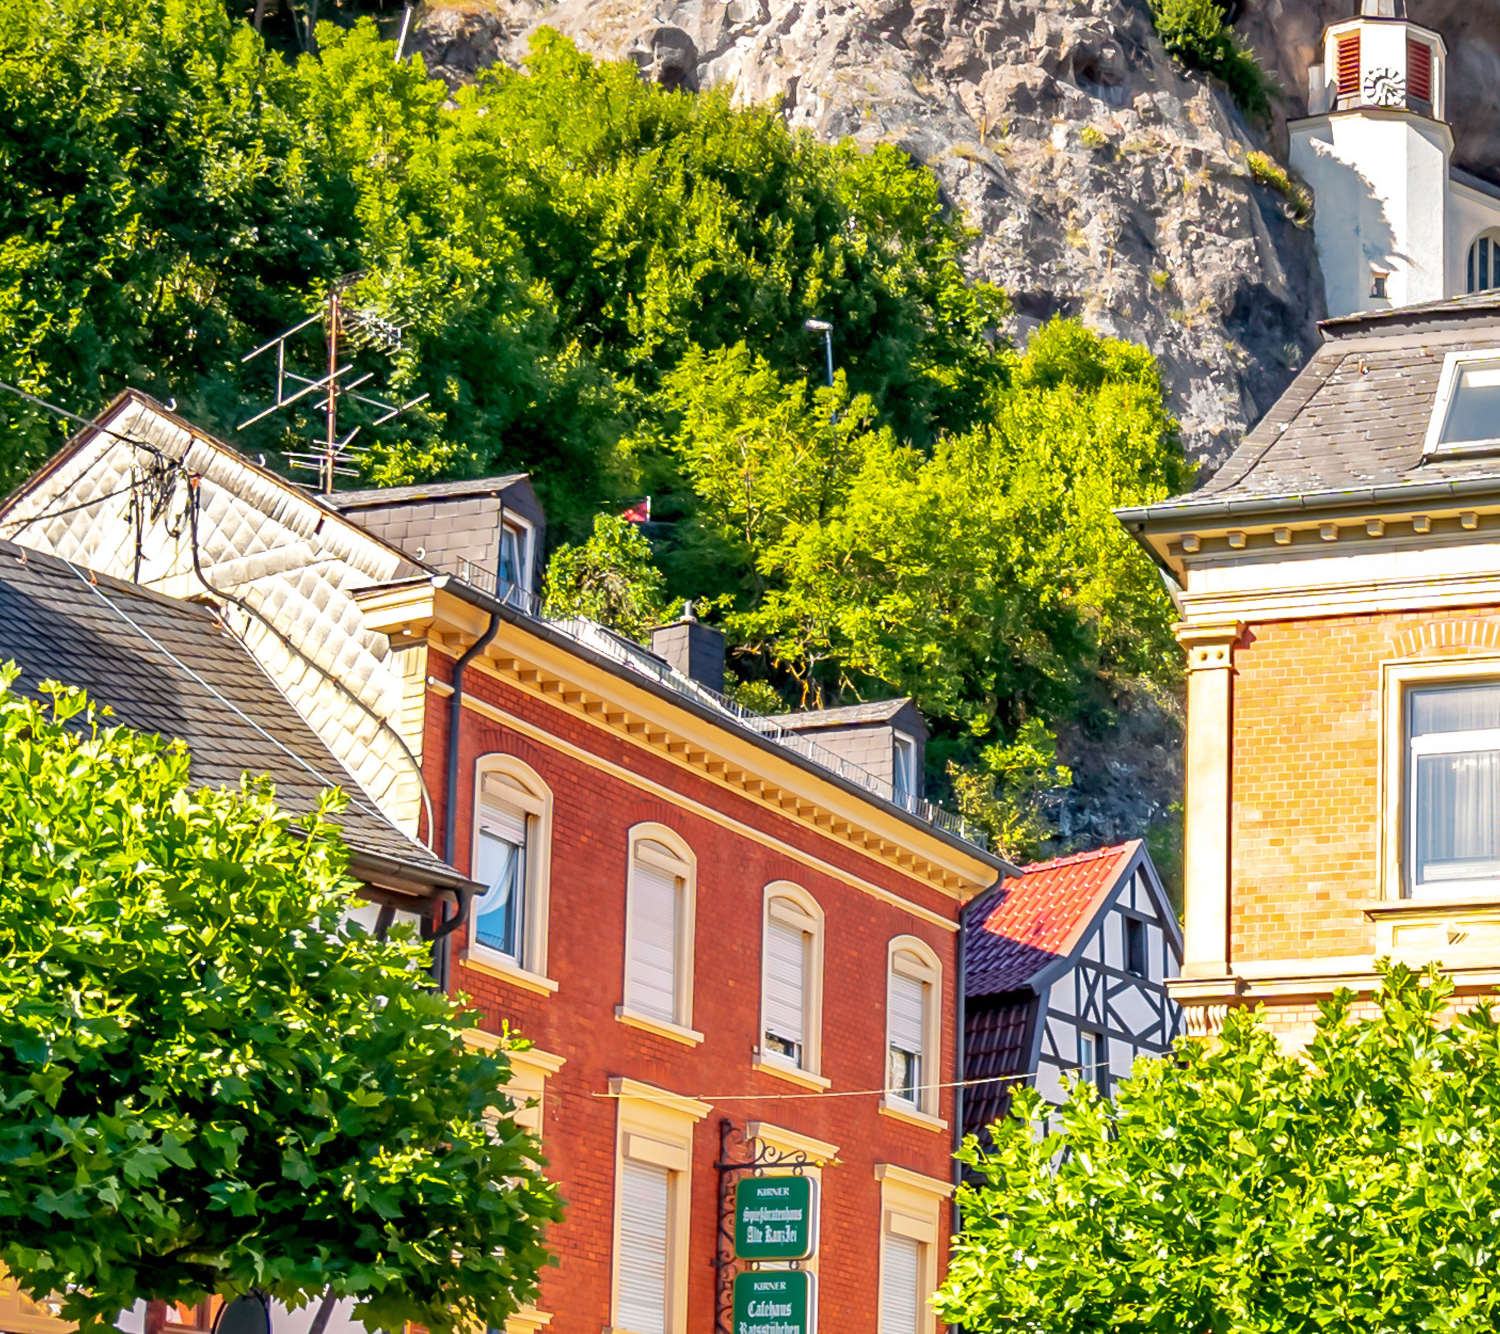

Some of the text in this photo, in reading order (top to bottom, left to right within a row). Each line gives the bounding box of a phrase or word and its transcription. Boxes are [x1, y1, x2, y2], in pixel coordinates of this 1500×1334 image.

[756, 1187, 790, 1197] KIRNER
[753, 1281, 787, 1291] KIRNER
[747, 1299, 793, 1320] Cafehaus
